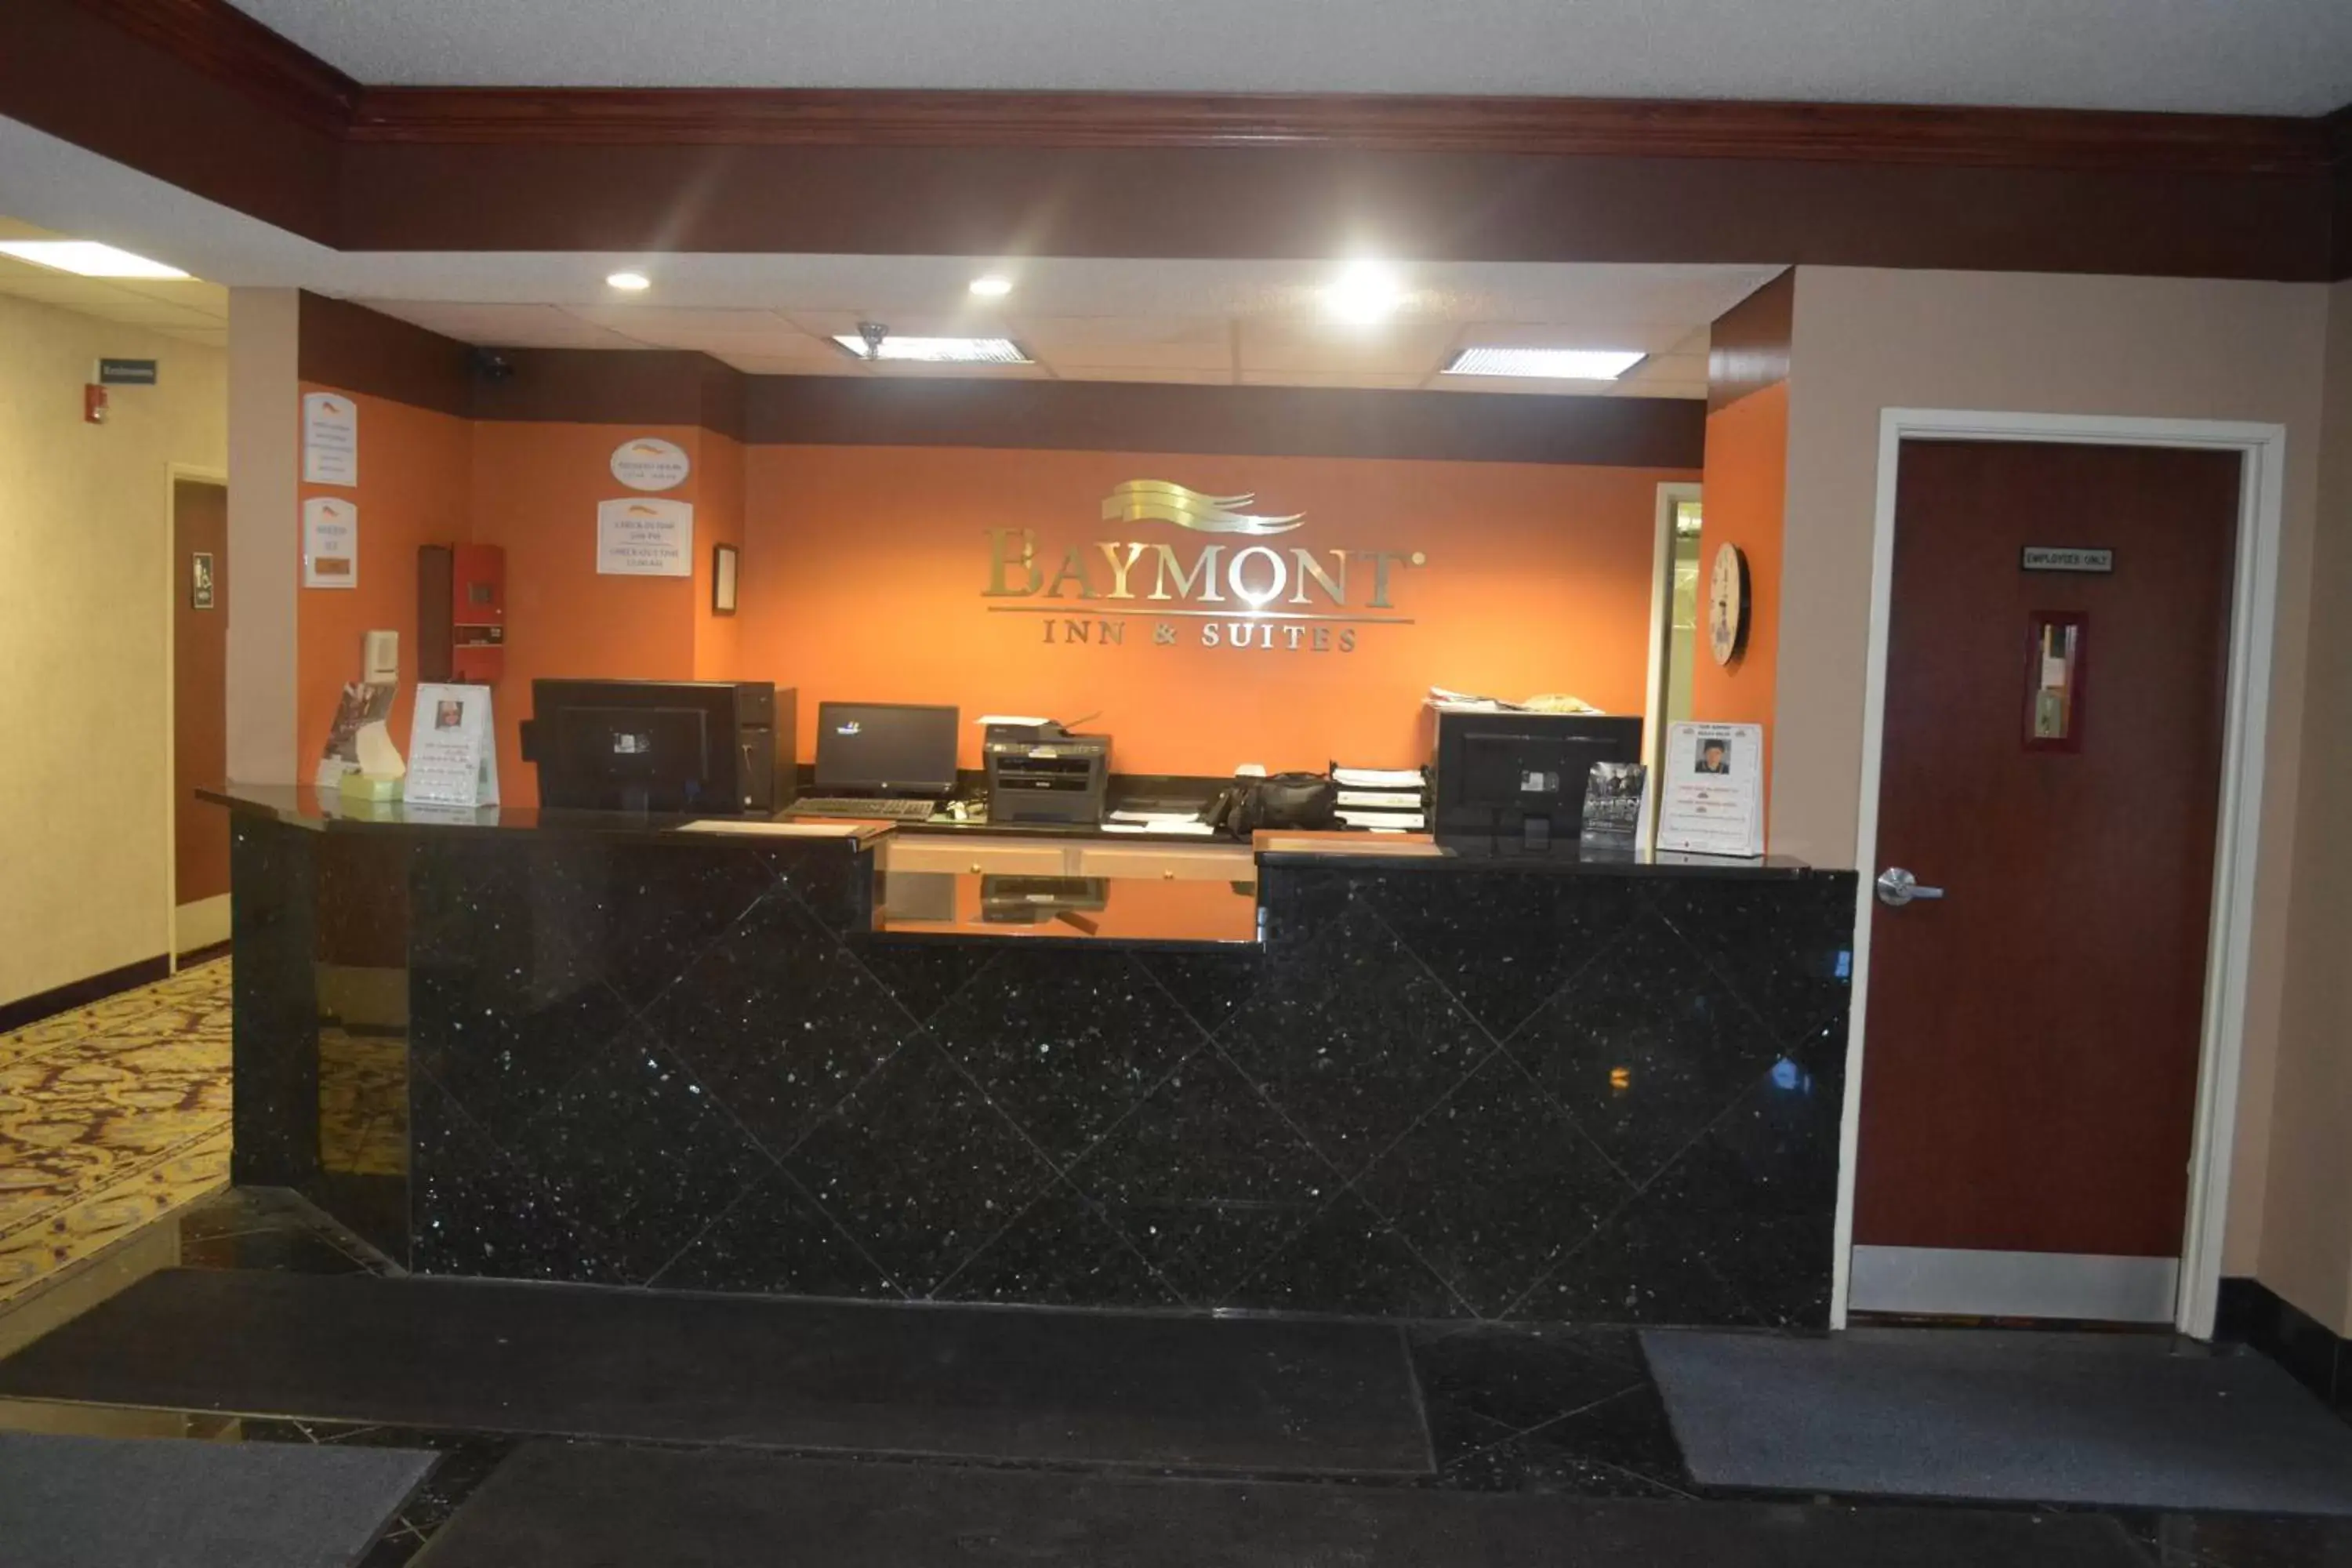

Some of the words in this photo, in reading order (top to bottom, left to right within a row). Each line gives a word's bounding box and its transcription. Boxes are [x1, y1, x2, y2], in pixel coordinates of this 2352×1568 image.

[982, 528, 1408, 609] BAYMONT
[1043, 619, 1125, 644] INN
[1152, 623, 1177, 645] &
[1201, 622, 1356, 652] SUITES
